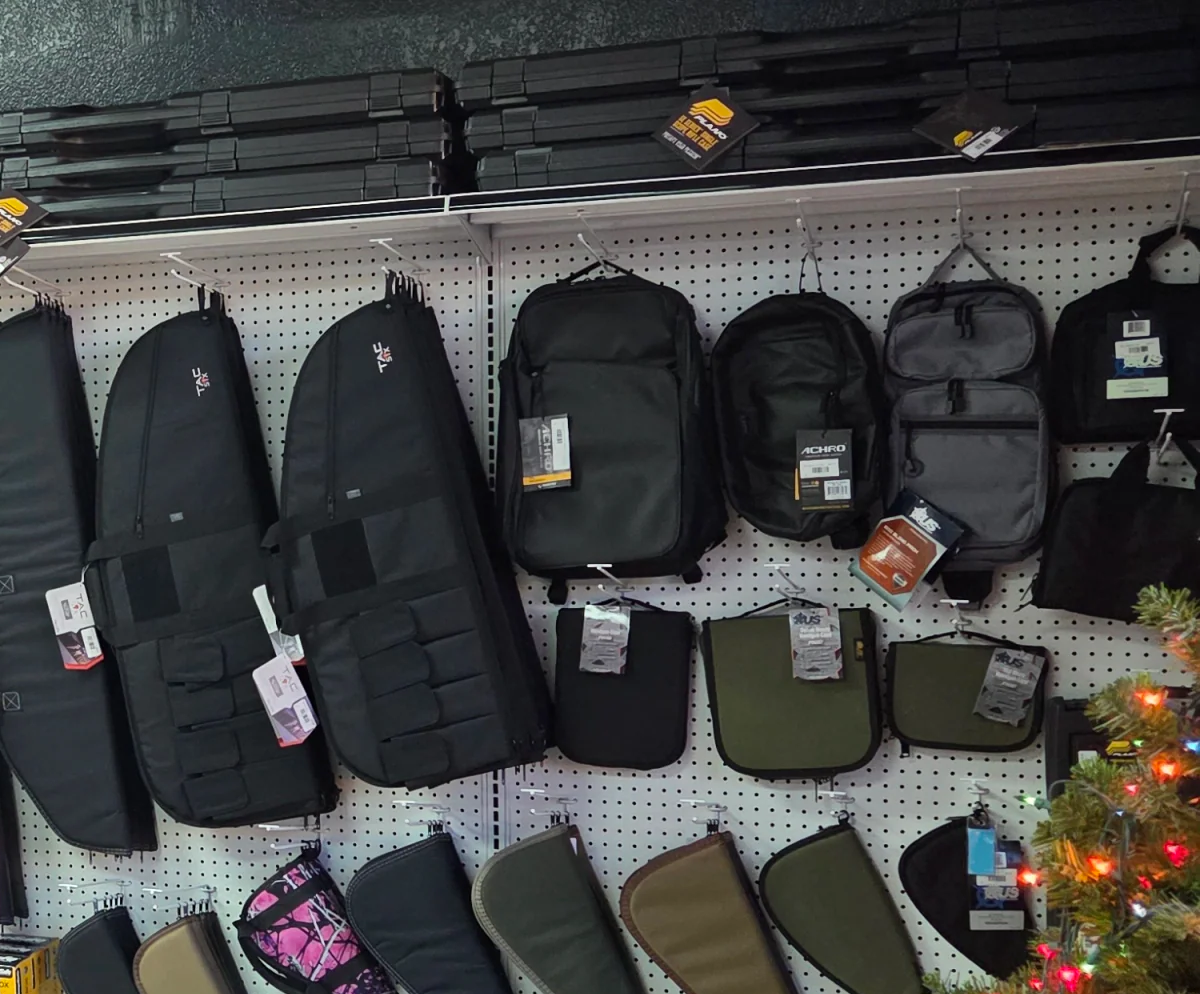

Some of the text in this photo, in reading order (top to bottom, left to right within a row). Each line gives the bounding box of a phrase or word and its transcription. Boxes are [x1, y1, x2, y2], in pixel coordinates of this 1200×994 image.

[694, 115, 728, 140] PLANO
[373, 342, 385, 373] TAC
[192, 368, 204, 396] TAC
[542, 423, 553, 473] ACHRO
[801, 445, 846, 454] ACHRO
[77, 593, 87, 619] TAC
[283, 666, 298, 693] TAC
